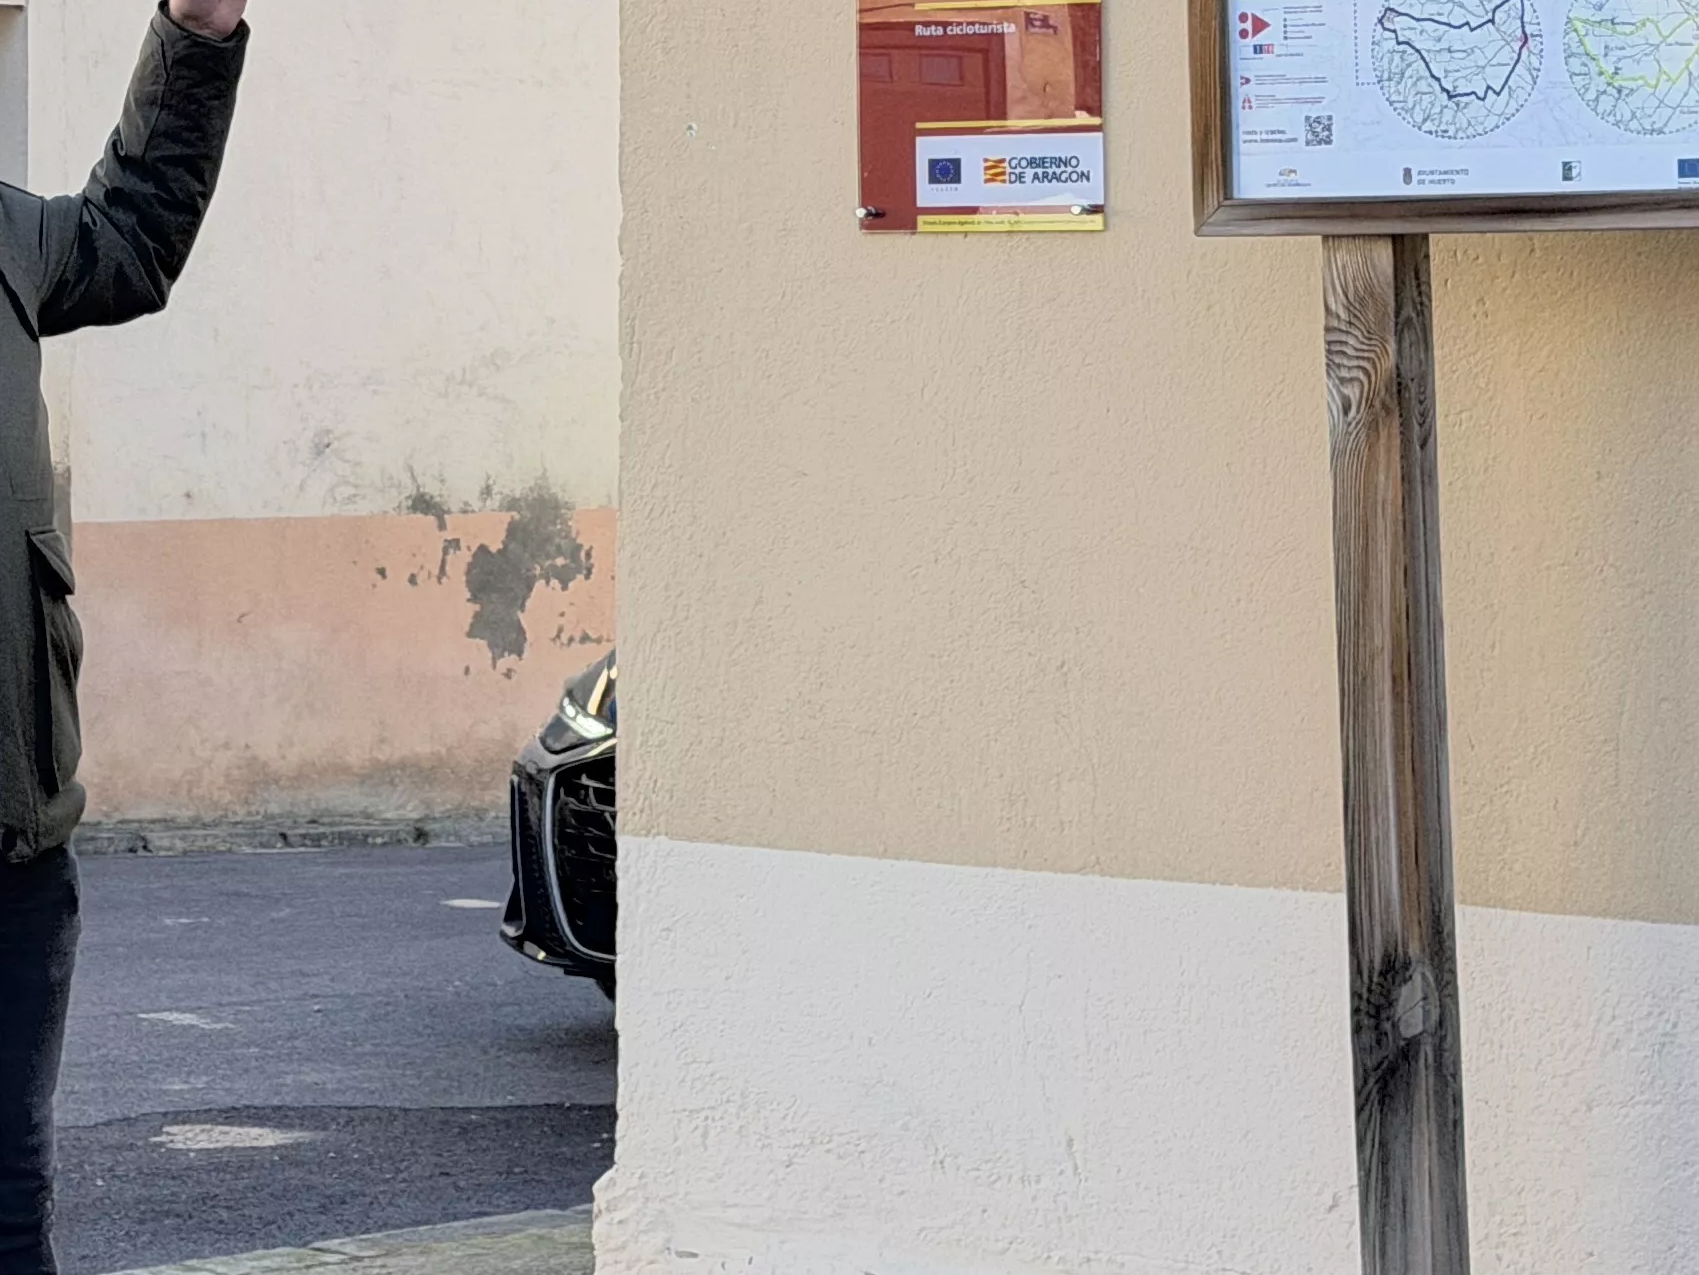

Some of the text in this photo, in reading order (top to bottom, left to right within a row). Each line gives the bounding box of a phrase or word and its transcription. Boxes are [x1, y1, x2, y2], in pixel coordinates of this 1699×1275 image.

[915, 24, 944, 36] Ruta
[946, 22, 1016, 35] cicloturista
[1008, 156, 1080, 170] GOBIERNO
[1008, 172, 1026, 184] DE
